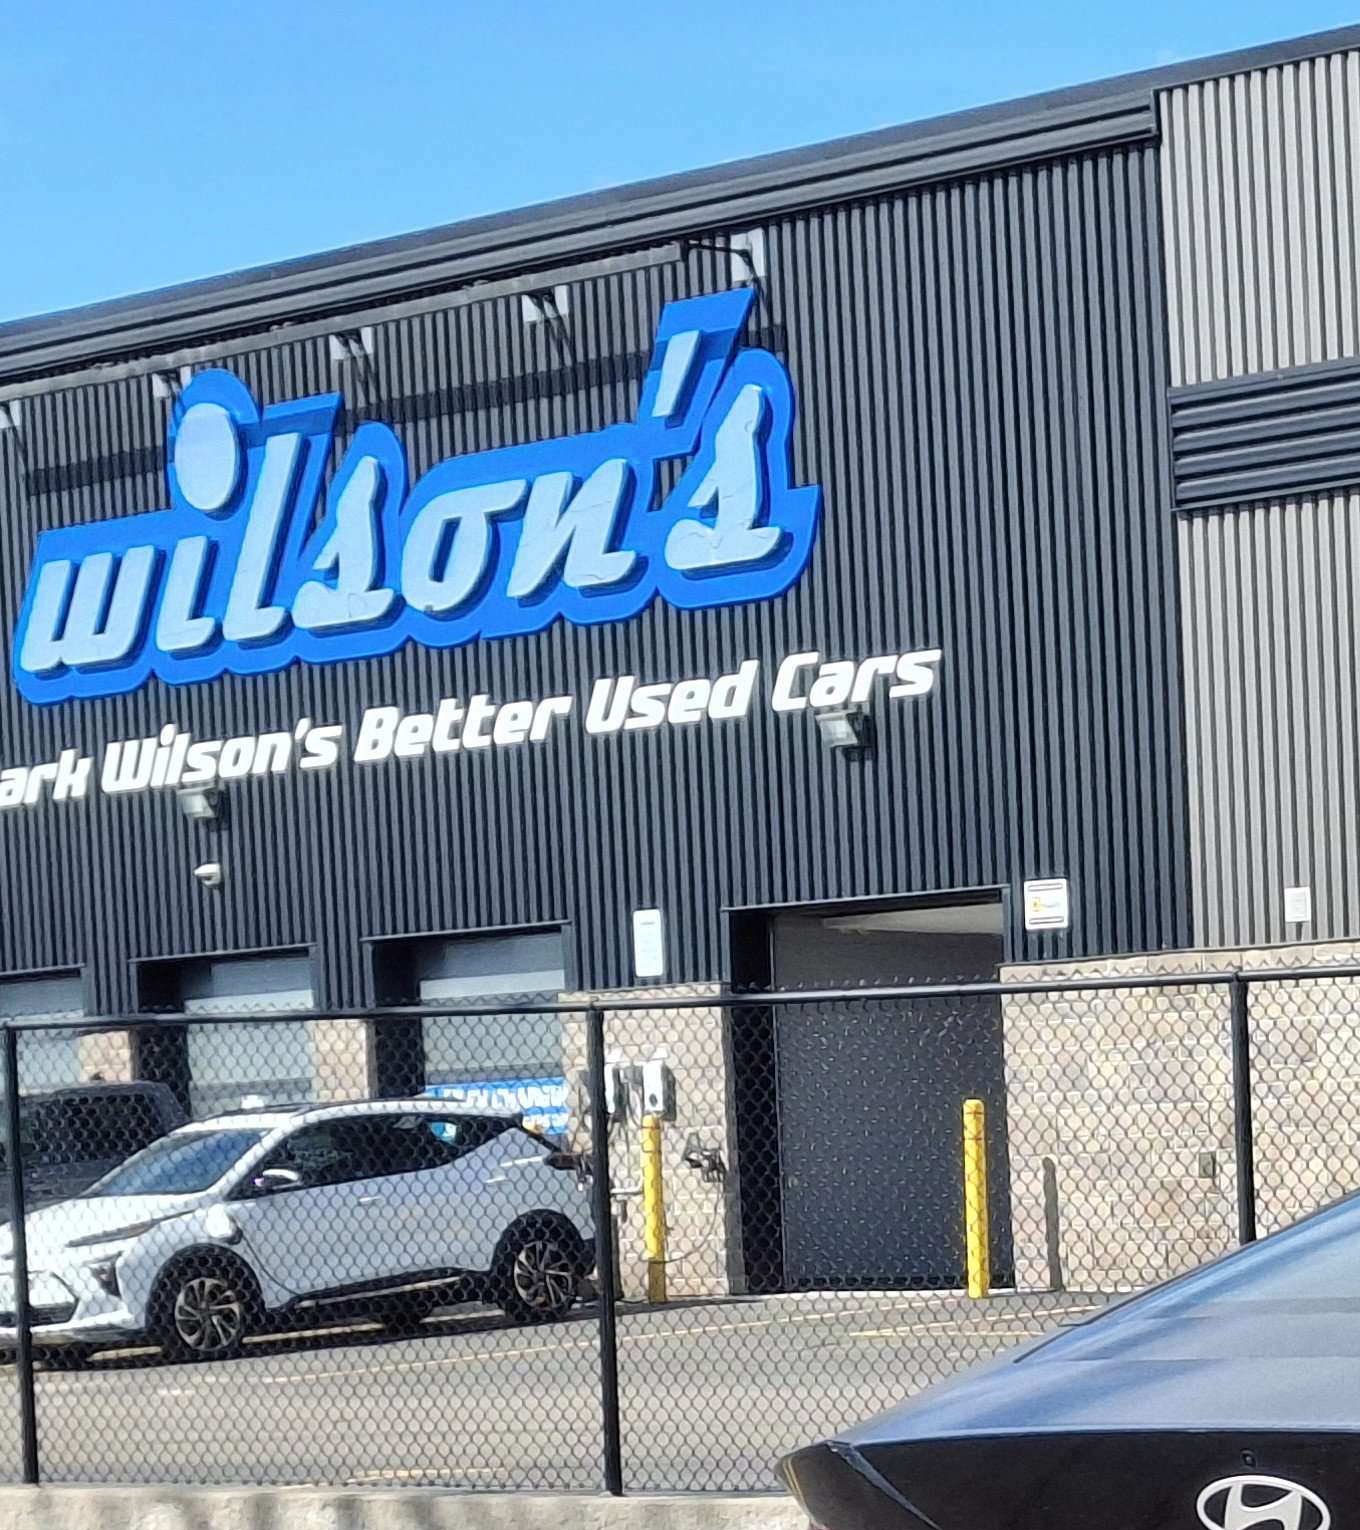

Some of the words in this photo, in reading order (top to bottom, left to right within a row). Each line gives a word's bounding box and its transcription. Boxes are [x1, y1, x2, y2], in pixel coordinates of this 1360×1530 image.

[19, 329, 784, 675] wilson's
[101, 717, 343, 793] Wilson's
[354, 693, 572, 763] Better
[585, 658, 759, 735] Used
[771, 648, 943, 712] Cars
